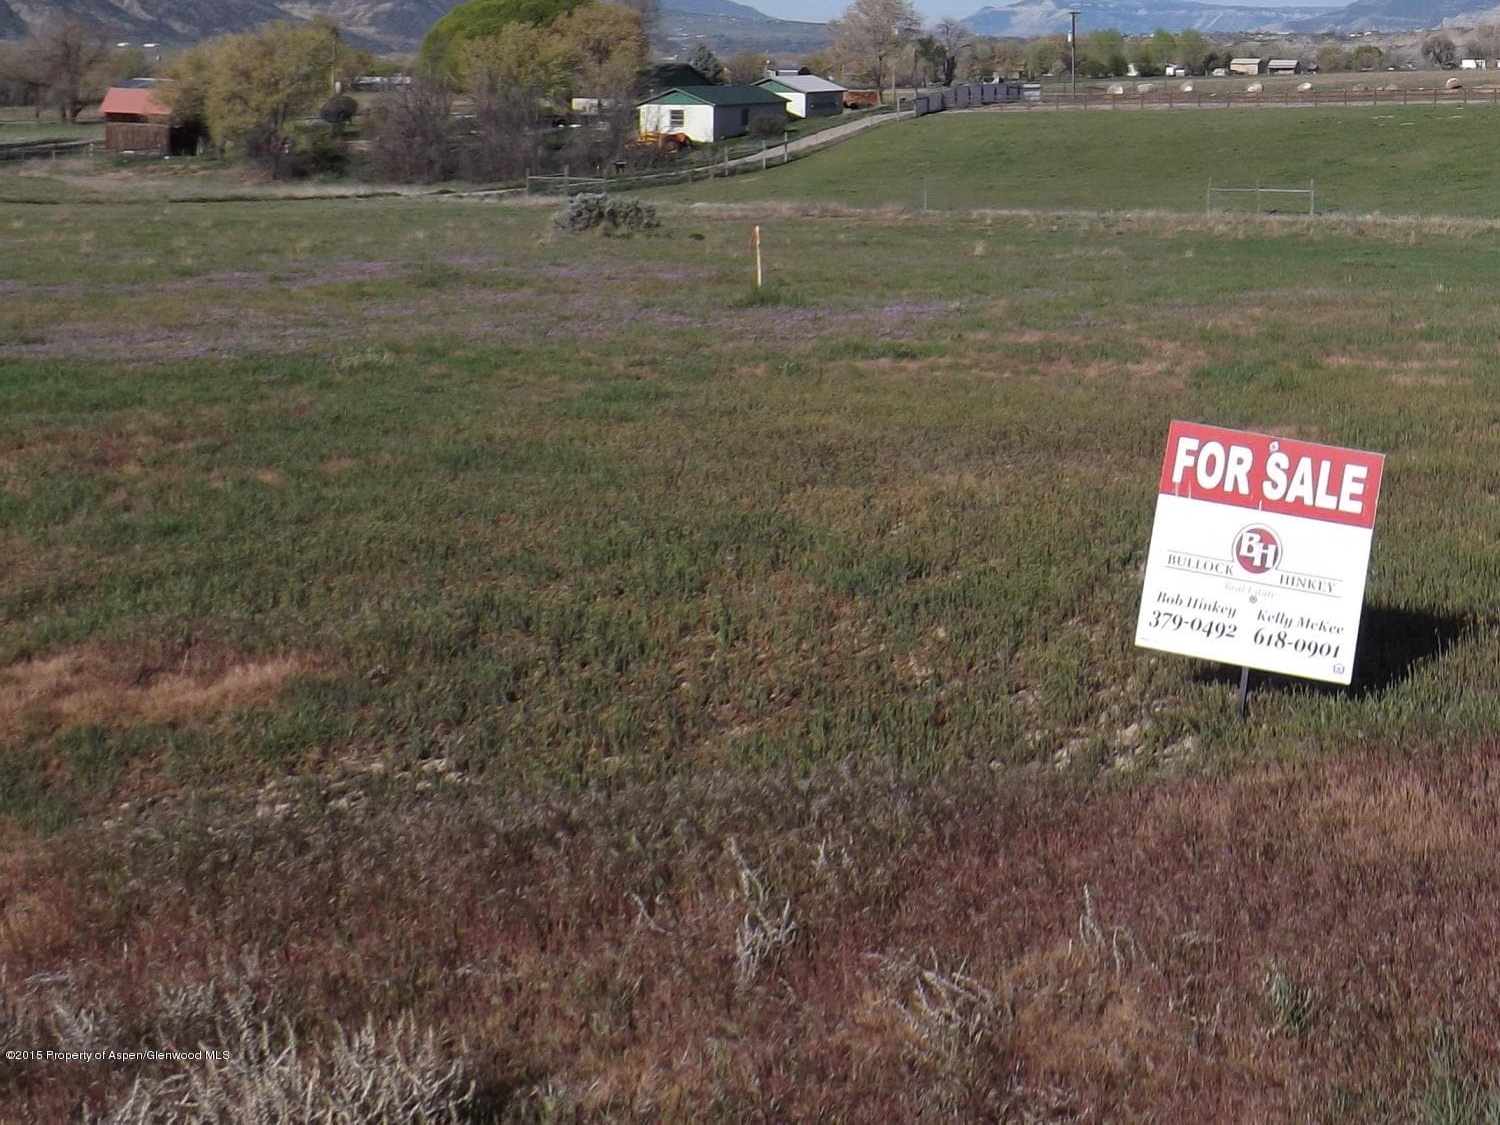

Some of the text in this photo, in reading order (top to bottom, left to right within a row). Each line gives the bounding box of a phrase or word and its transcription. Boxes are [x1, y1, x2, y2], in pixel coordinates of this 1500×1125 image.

[1172, 436, 1368, 514] FOR SALE
[1239, 530, 1278, 569] BH
[1166, 554, 1235, 576] BULLOCK
[1279, 574, 1336, 594] HINKEY
[1156, 591, 1237, 618] Bob Hinkey
[1149, 610, 1238, 639] 379-0492
[1256, 609, 1345, 636] Kelly McKee
[1253, 627, 1340, 658] 618-0901
